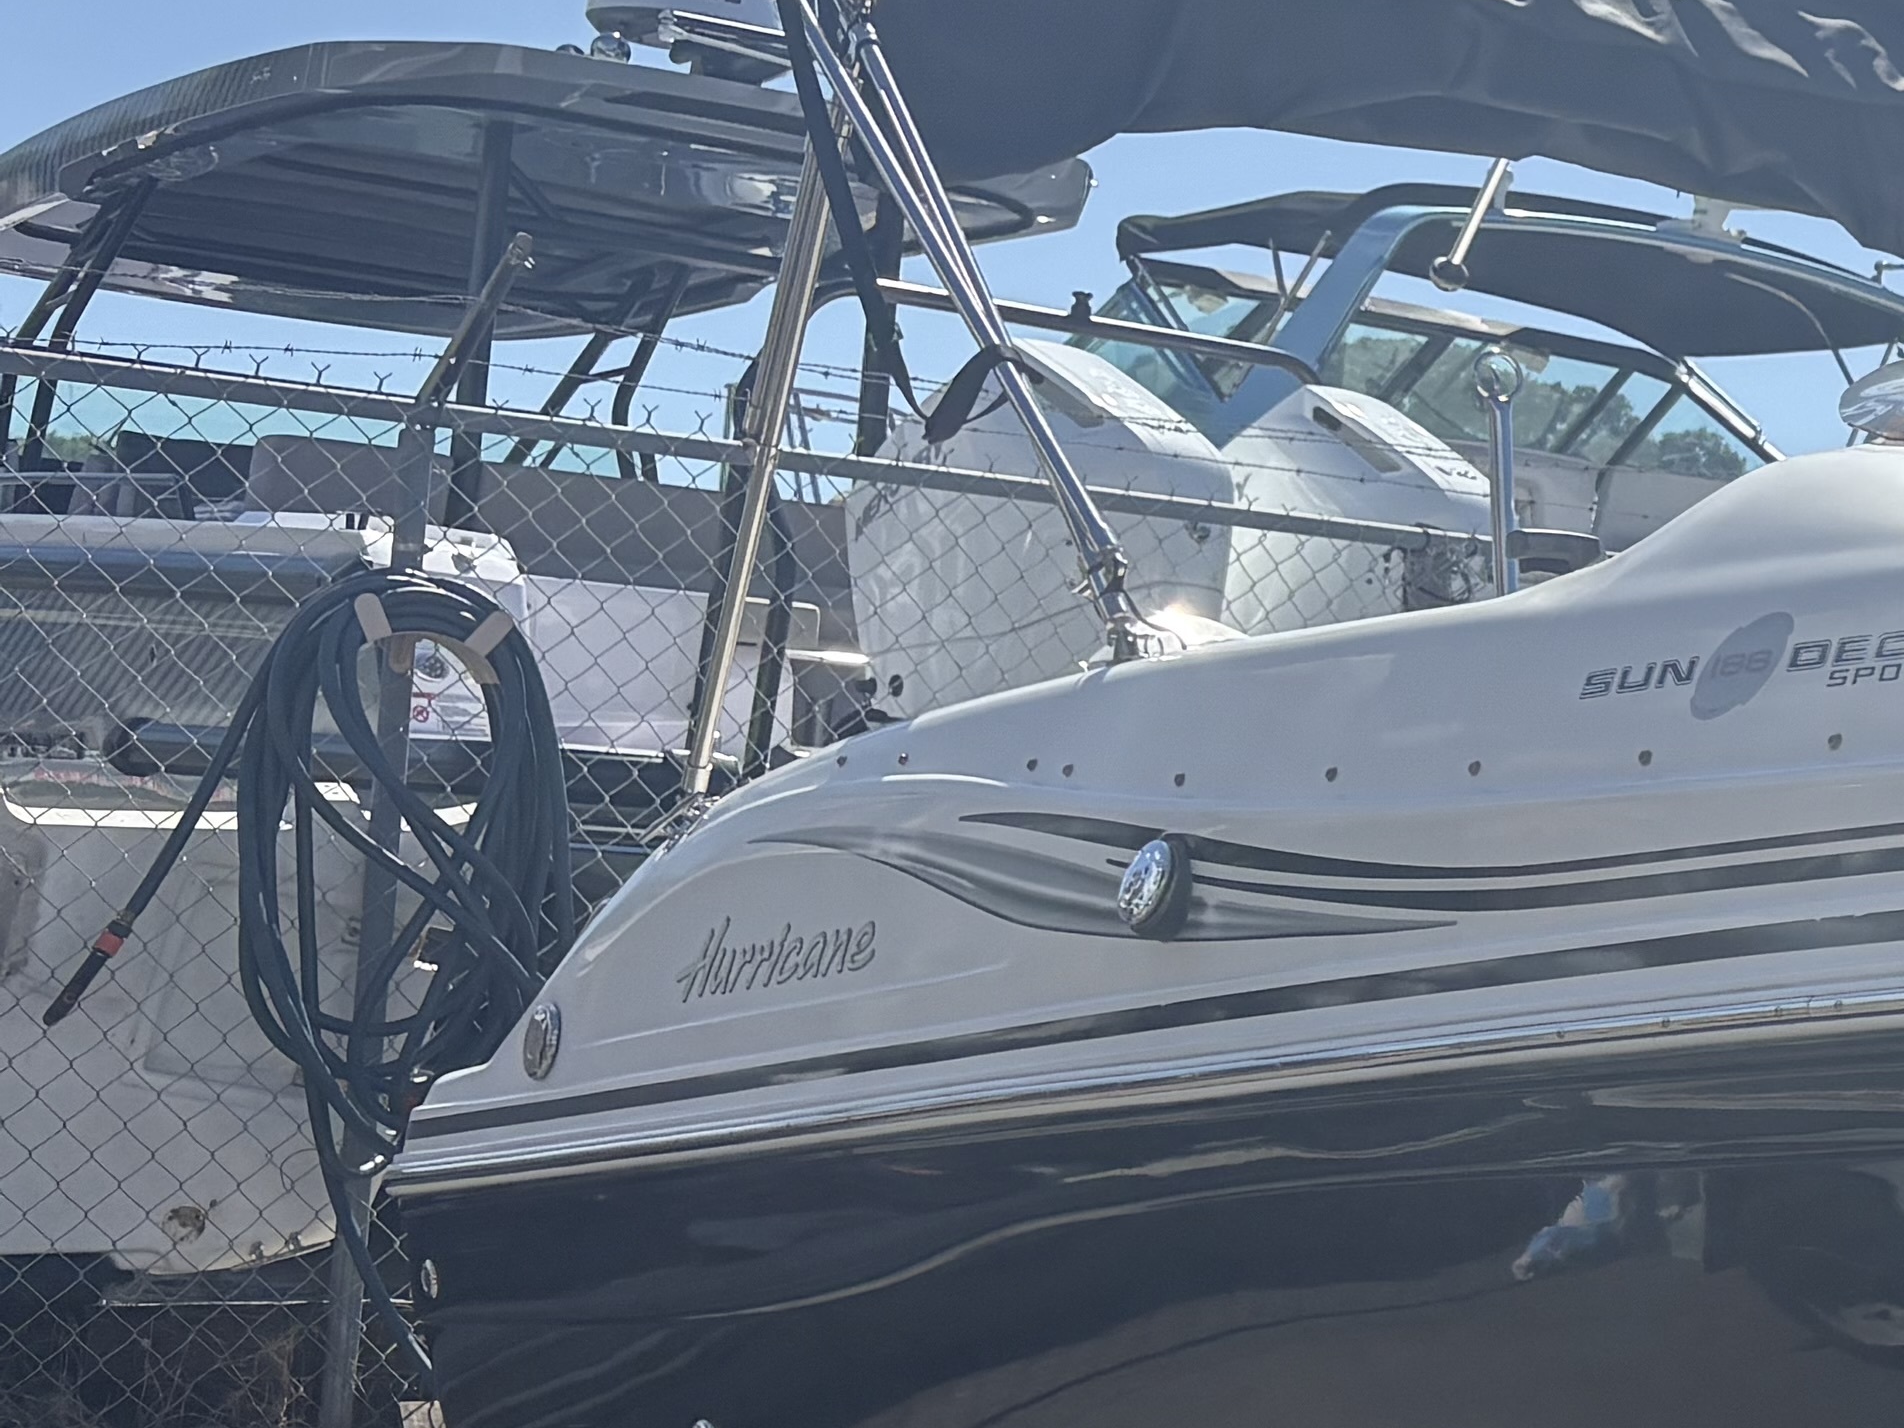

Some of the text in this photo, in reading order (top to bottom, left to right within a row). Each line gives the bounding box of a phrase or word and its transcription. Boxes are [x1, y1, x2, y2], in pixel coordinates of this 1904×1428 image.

[1579, 655, 1700, 700] SUN
[1711, 649, 1774, 679] 188
[676, 915, 876, 1004] Hurricane
